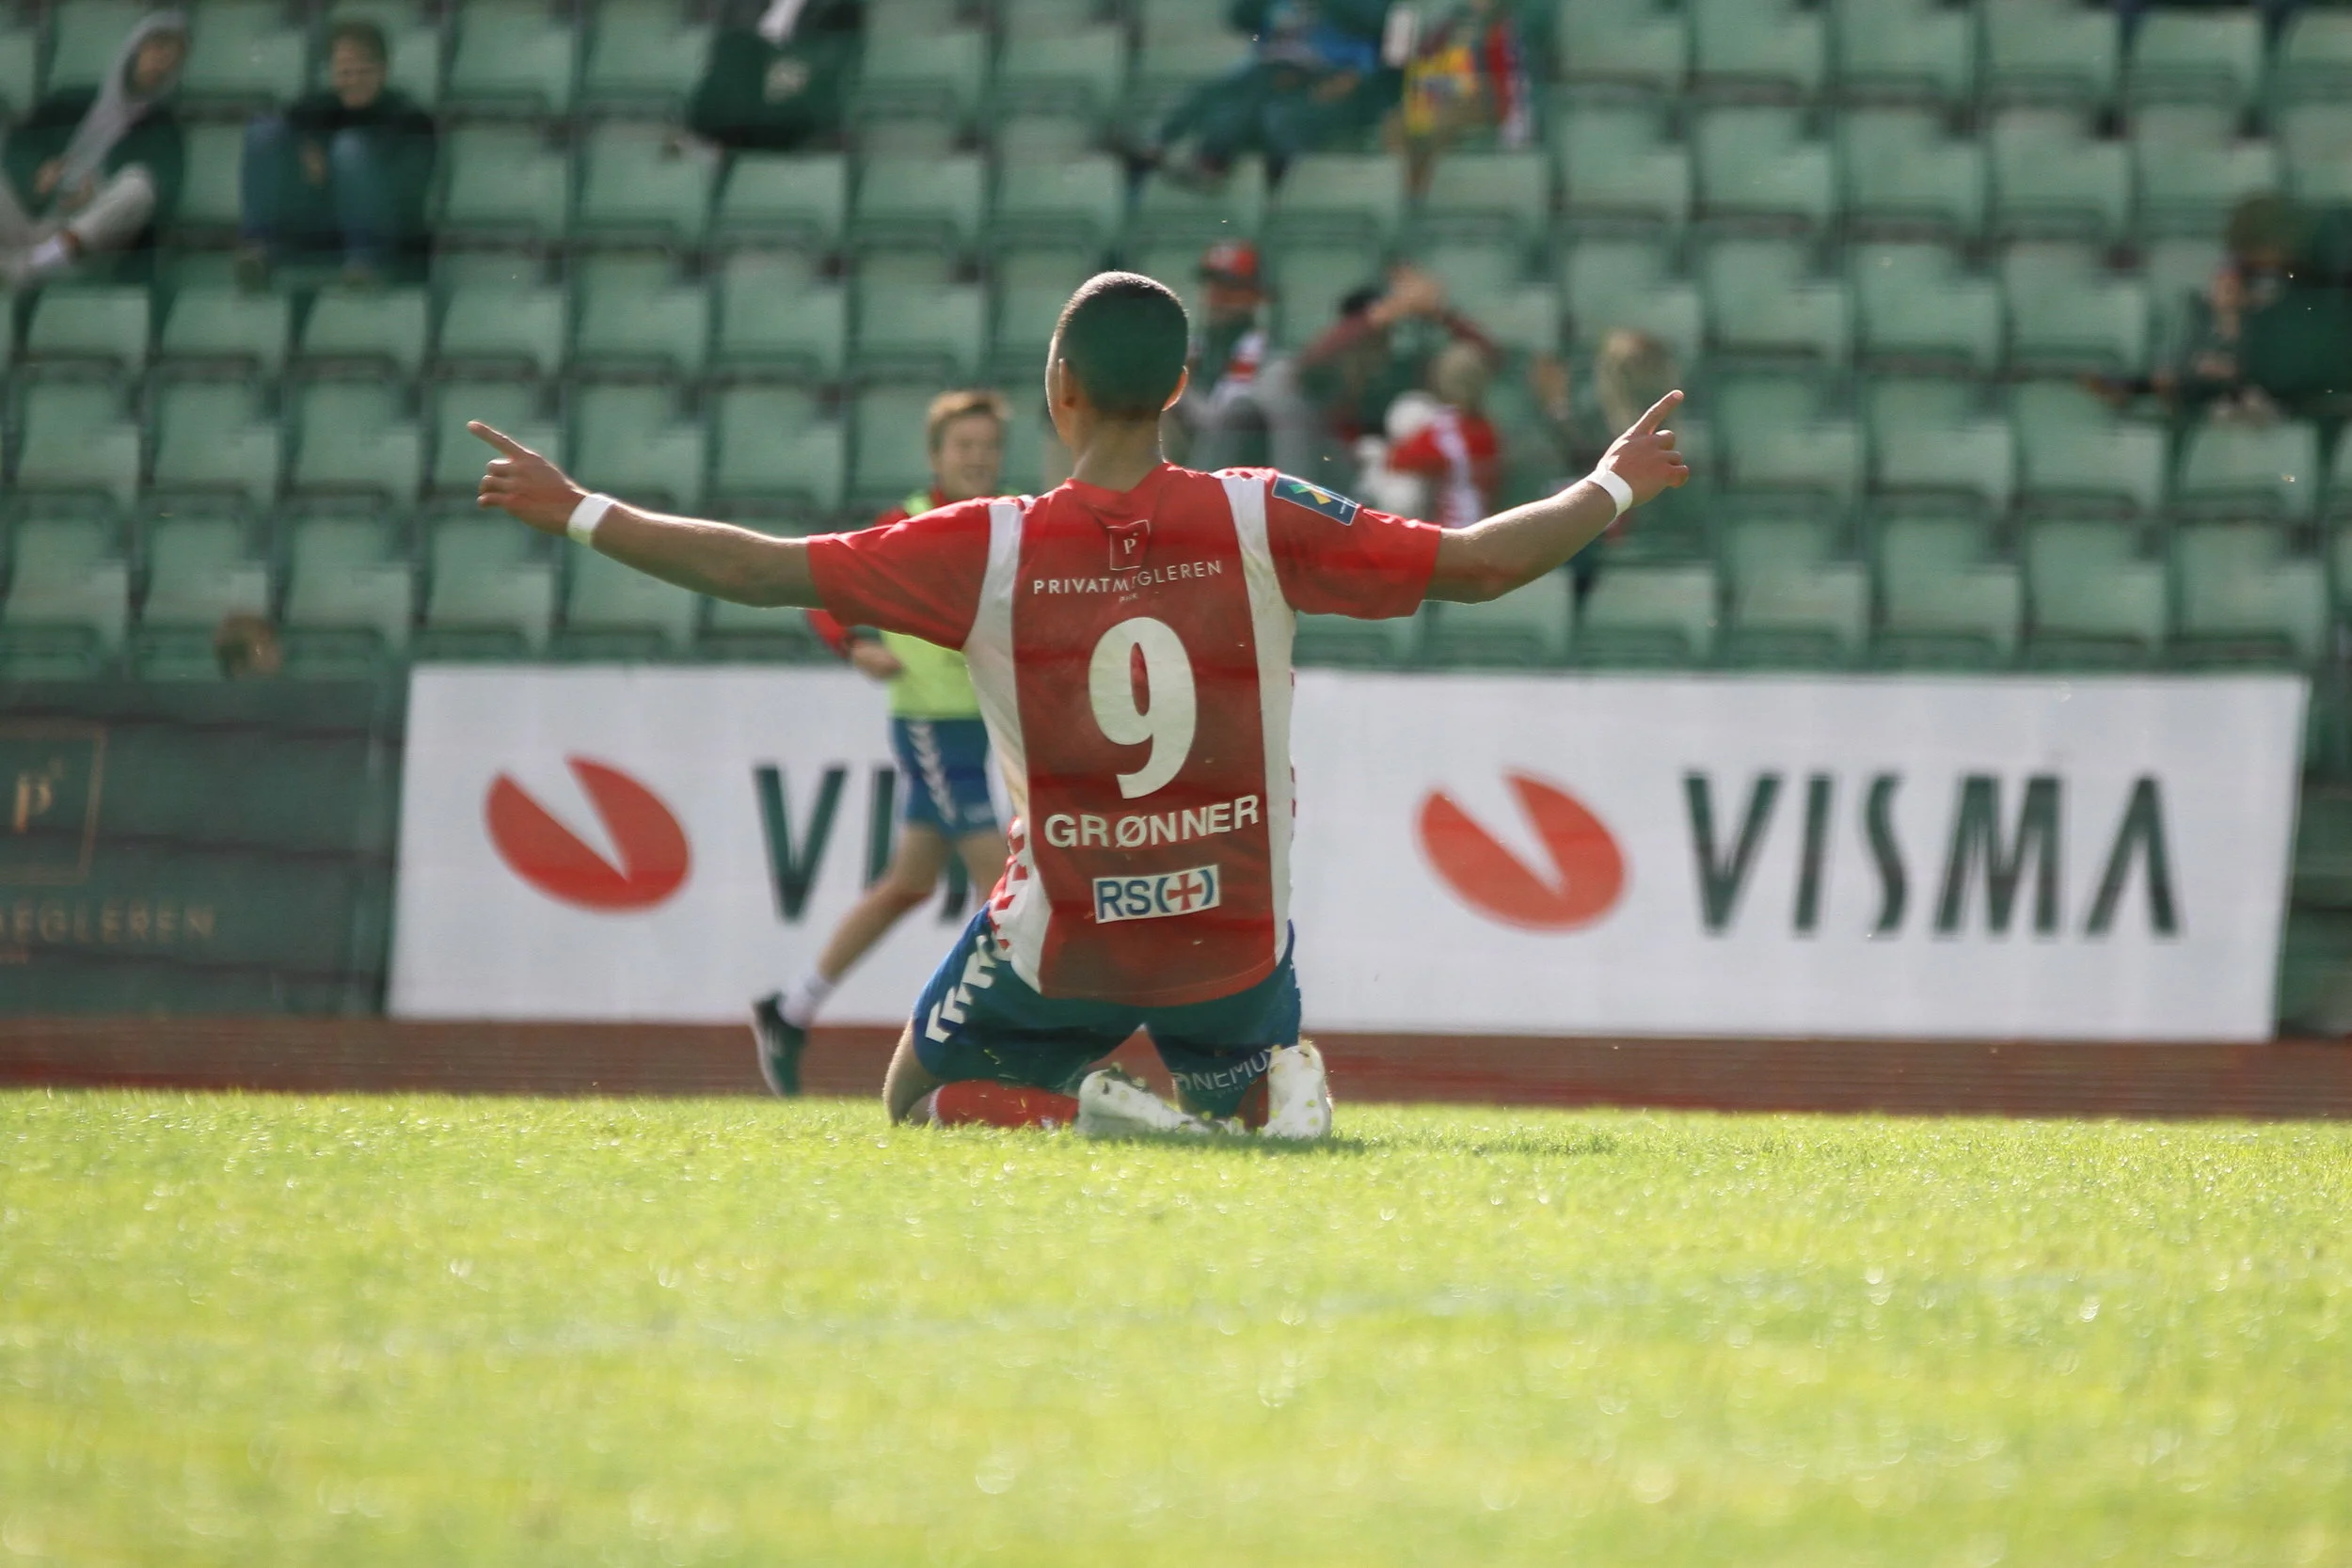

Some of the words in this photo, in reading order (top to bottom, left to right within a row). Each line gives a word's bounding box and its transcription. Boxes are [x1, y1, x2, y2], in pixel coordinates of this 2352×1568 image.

[1089, 617, 1197, 800] 9
[1044, 795, 1260, 847] GRØNNER
[1682, 771, 2180, 936] VISMA
[0, 896, 216, 943] EGLEREN
